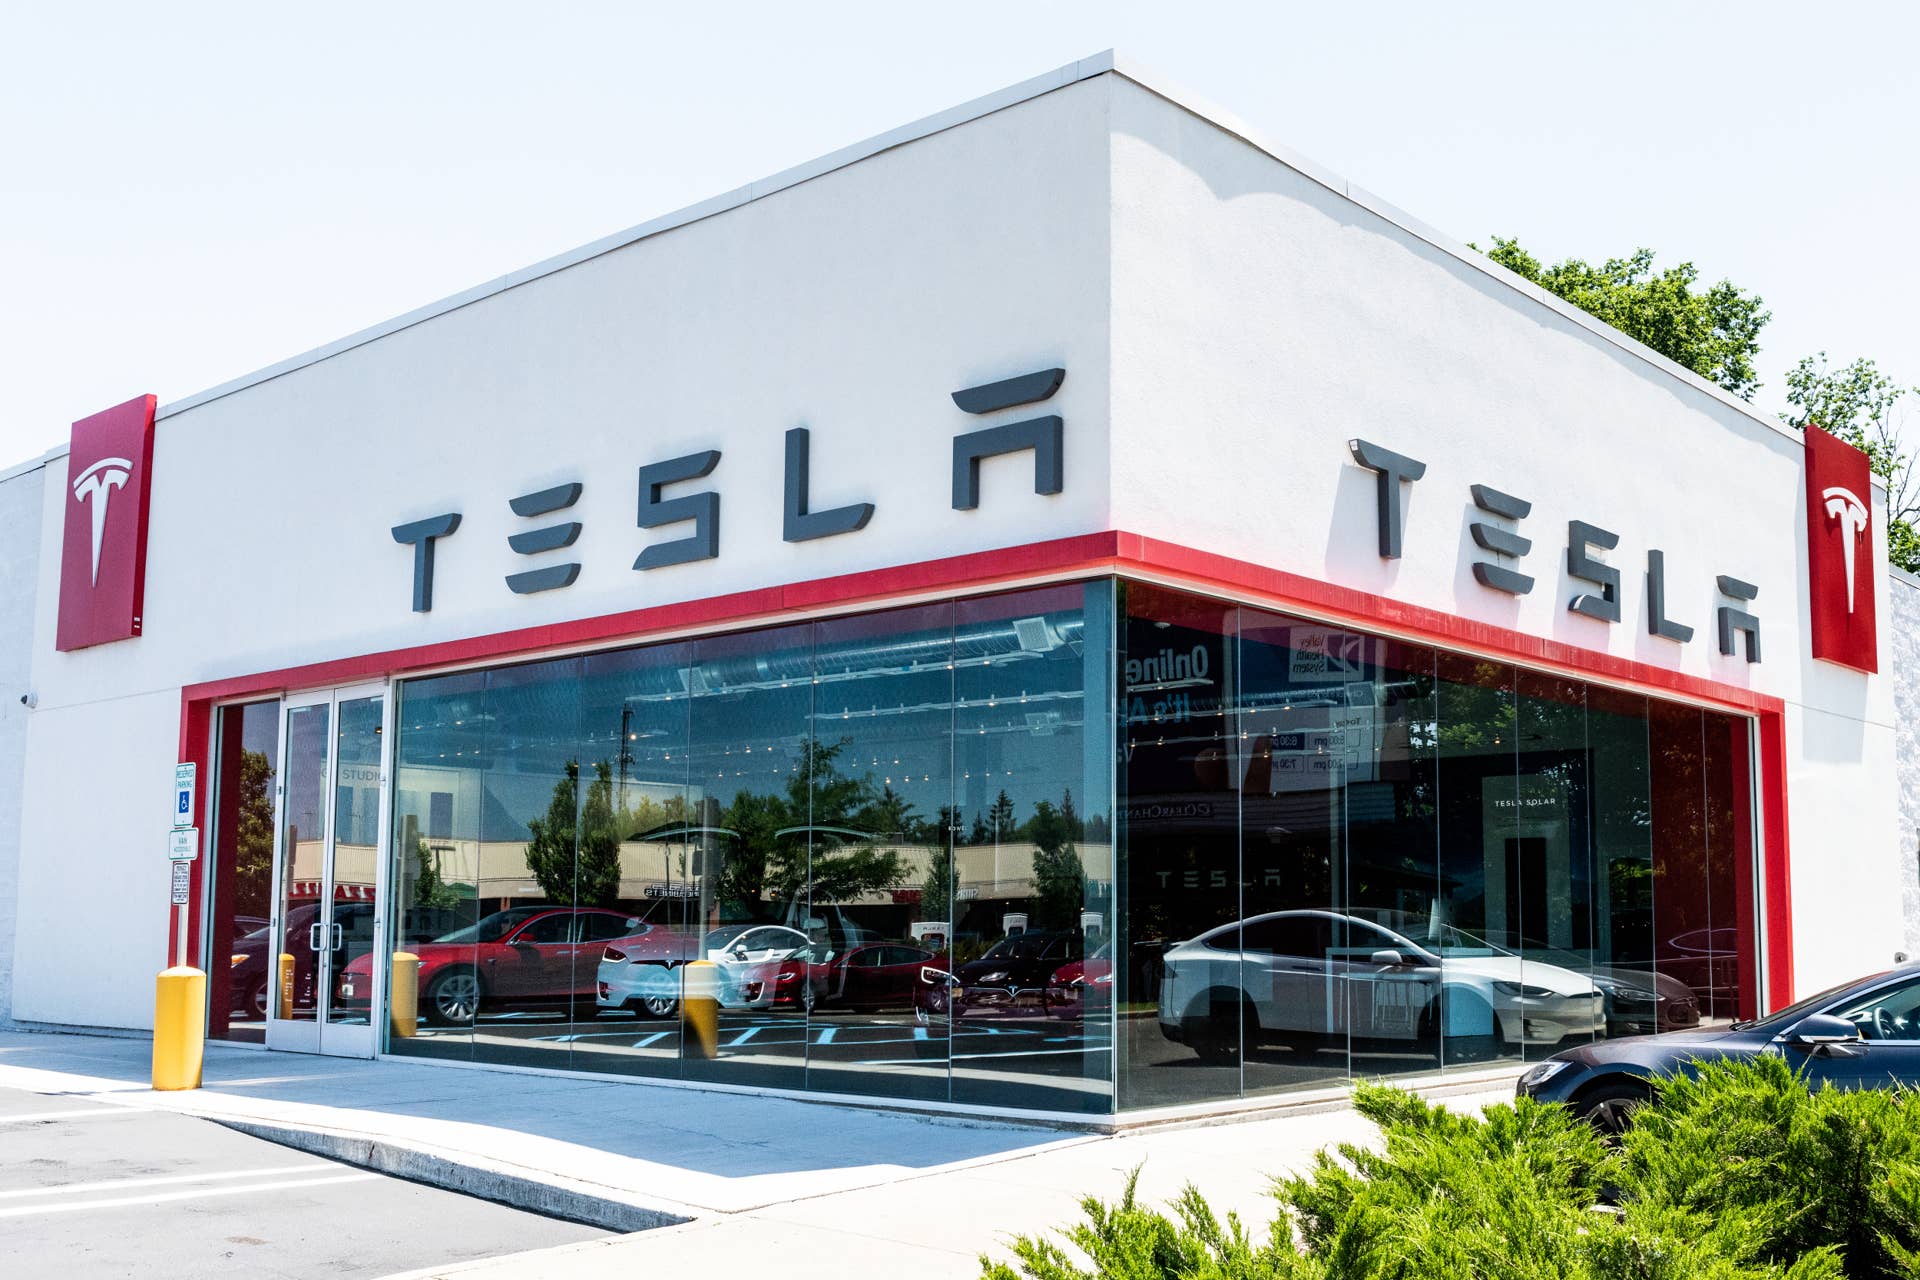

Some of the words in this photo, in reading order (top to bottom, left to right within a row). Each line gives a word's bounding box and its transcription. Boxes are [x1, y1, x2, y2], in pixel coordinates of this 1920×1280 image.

[391, 368, 1065, 613] TESLA
[1348, 438, 1762, 664] TESLA
[1525, 798, 1556, 806] SOLAR
